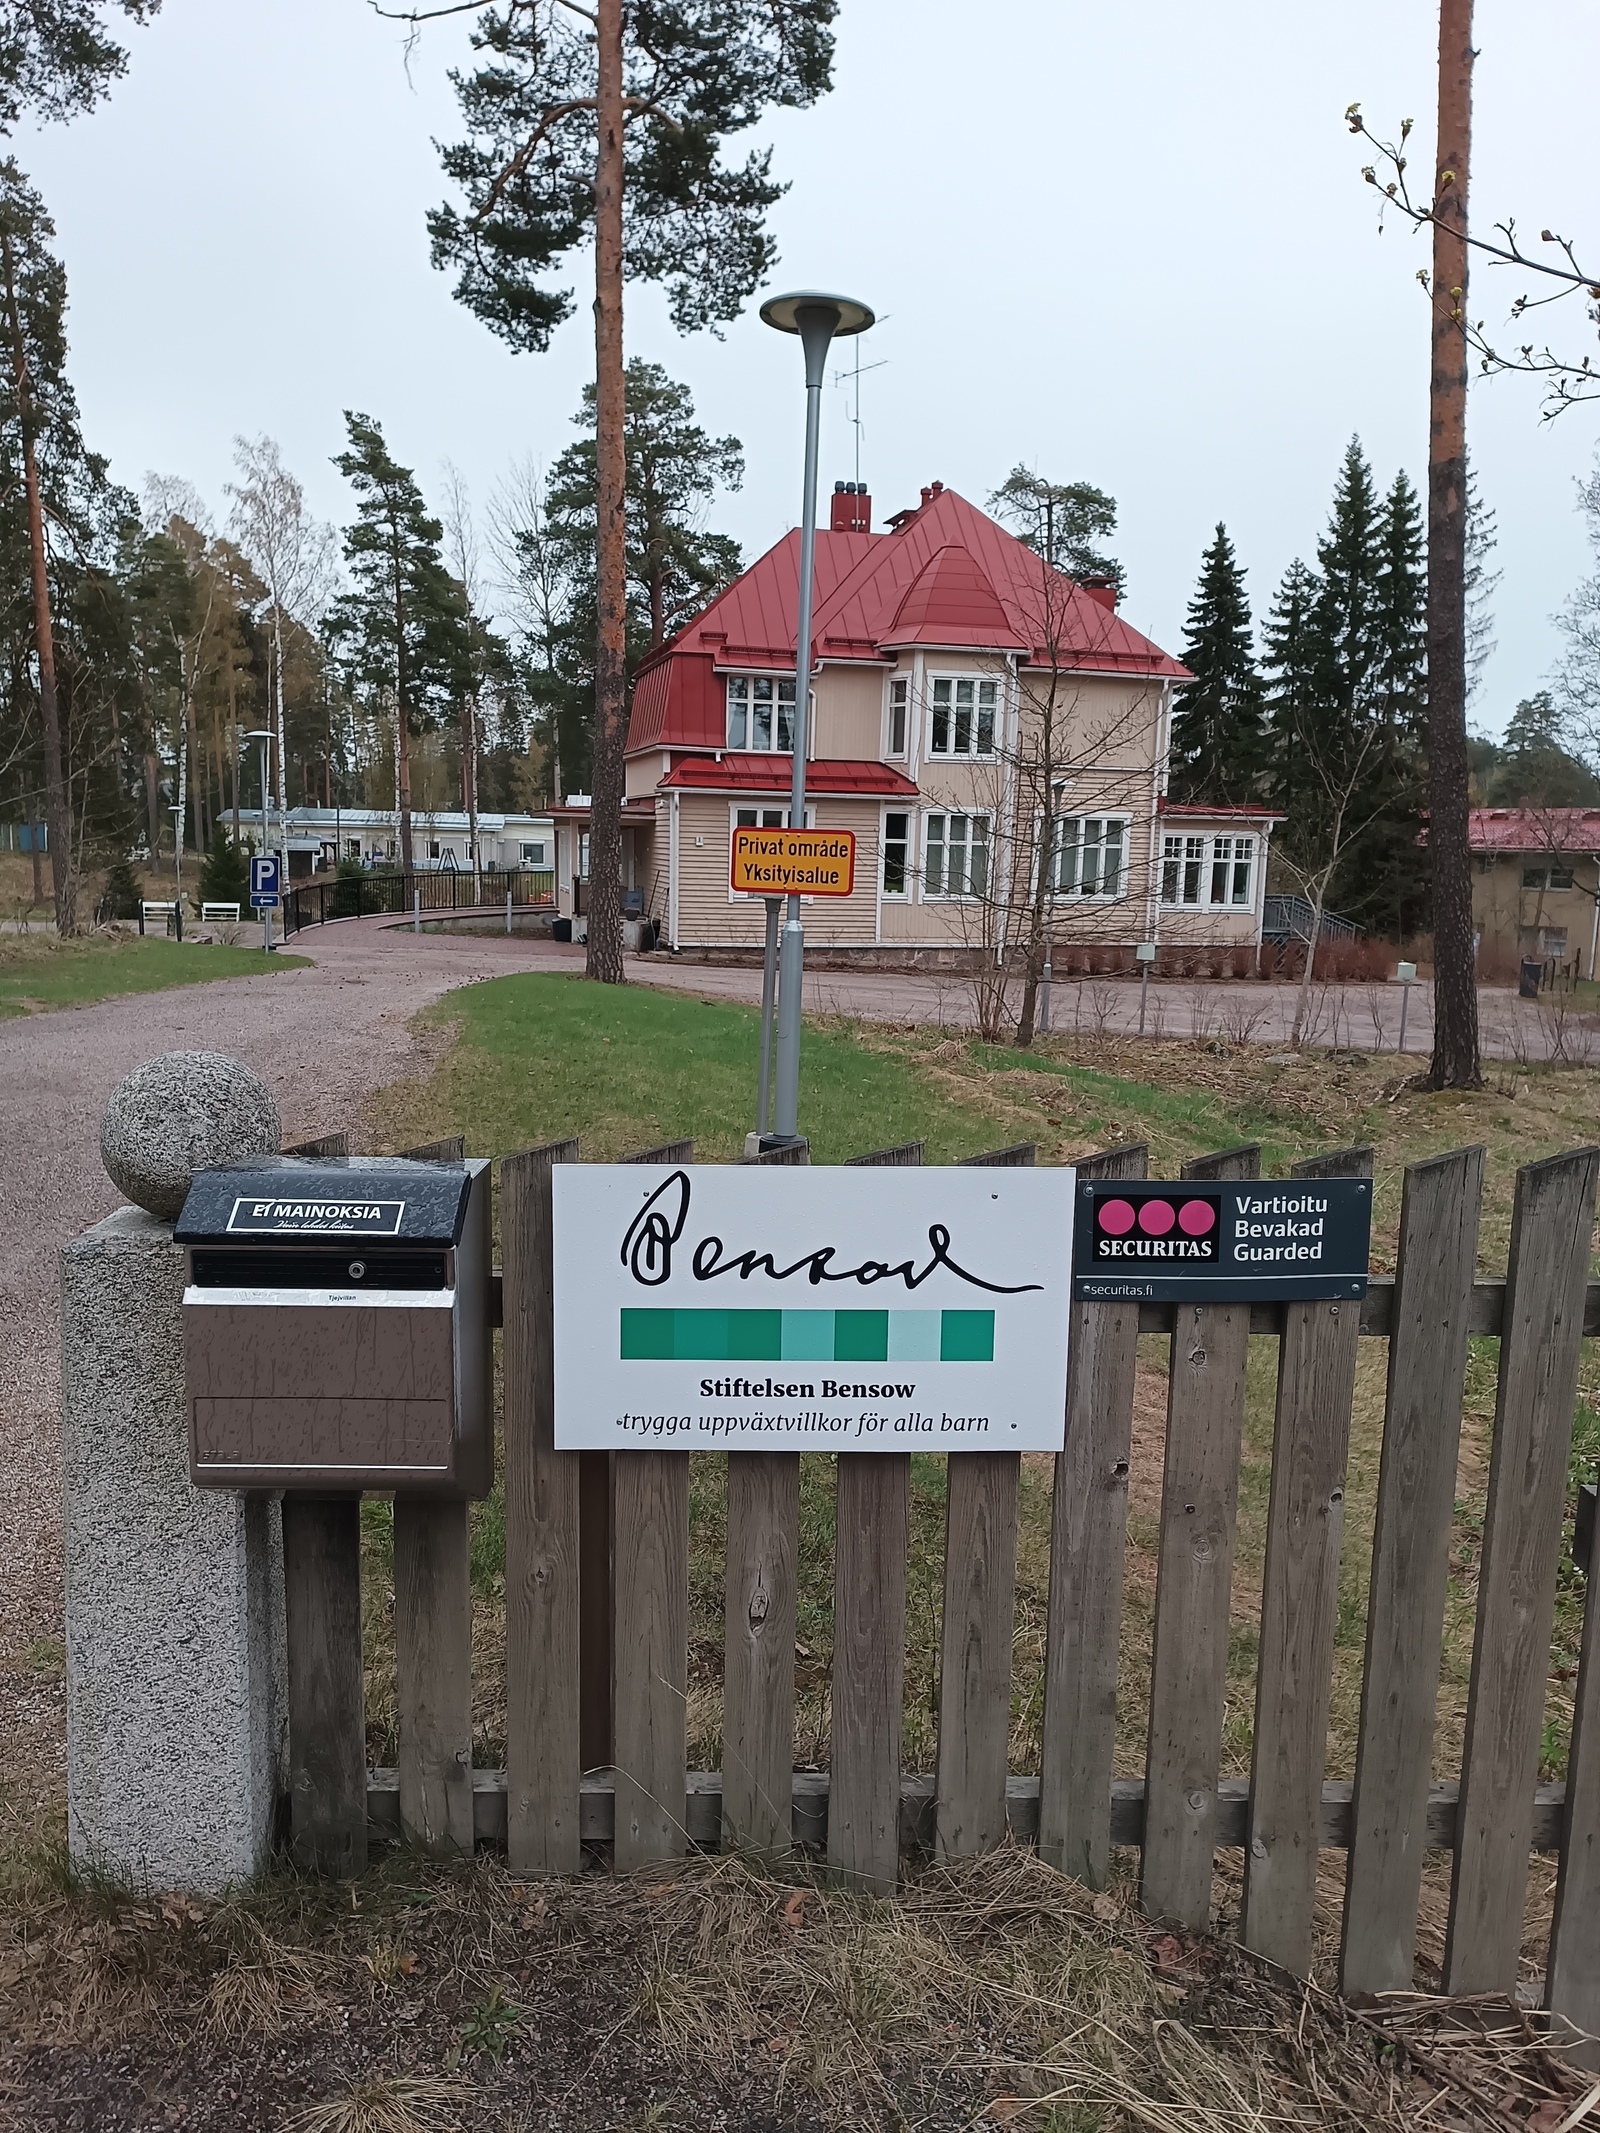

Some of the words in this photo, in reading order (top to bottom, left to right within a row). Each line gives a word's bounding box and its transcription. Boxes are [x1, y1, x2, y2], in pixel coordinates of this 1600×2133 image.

[738, 836, 784, 855] Privat
[788, 840, 848, 858] område
[257, 860, 275, 890] P
[743, 863, 839, 885] Yksityisalue
[252, 1202, 275, 1217] EI
[274, 1204, 381, 1219] MAINOKSIA
[1235, 1195, 1328, 1214] Vartioitu
[1234, 1218, 1324, 1238] Bevakad
[1098, 1239, 1212, 1257] SECURITAS
[1233, 1241, 1323, 1262] Guarded
[1091, 1284, 1153, 1296] securitas.fi
[699, 1377, 816, 1399] Stiftelsen
[821, 1379, 916, 1399] Bensow
[622, 1412, 691, 1437] trygga
[698, 1411, 852, 1436] uppväxtvillkor
[855, 1412, 889, 1437] för
[893, 1412, 933, 1432] alla
[939, 1412, 989, 1432] barn
